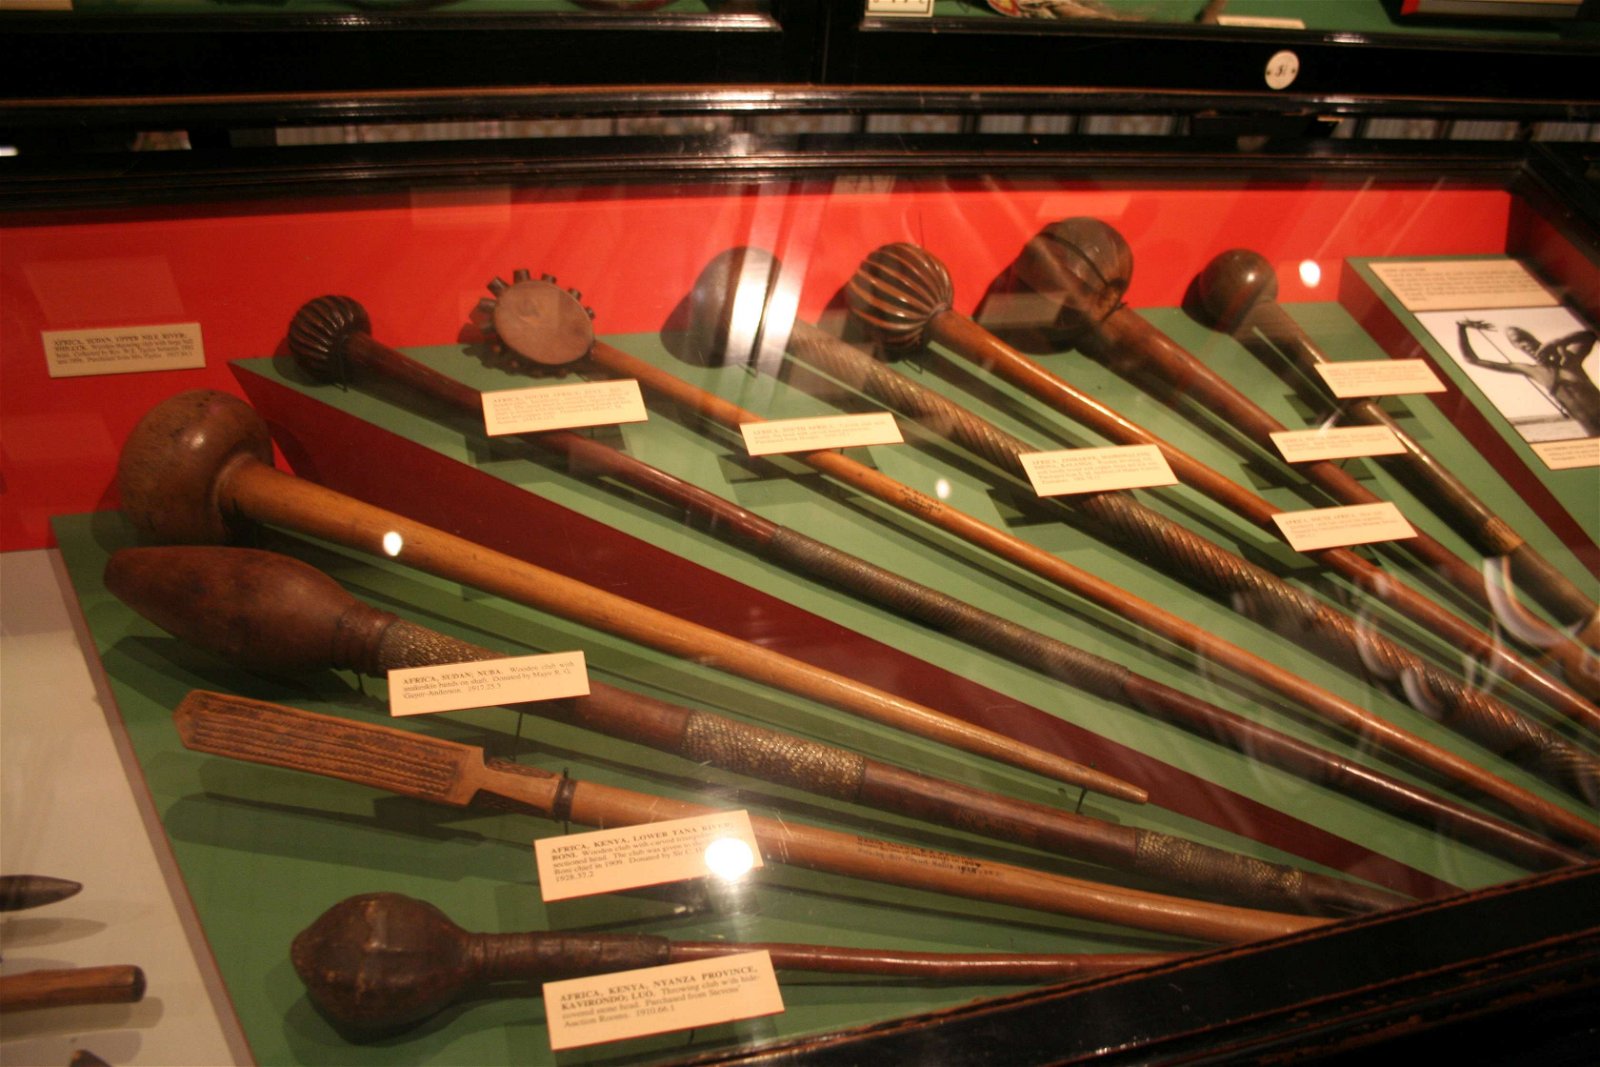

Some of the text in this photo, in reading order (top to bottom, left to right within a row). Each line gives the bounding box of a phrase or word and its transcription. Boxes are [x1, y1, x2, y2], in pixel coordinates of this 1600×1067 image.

[404, 676, 439, 685] AFRICA,
[552, 844, 590, 855] AFRICA,
[595, 838, 630, 849] KENYA,
[634, 832, 668, 842] LOWER
[673, 828, 697, 836] TANA
[561, 966, 758, 1003] AFRICA, KENYA, NYANZA PROVINCE,
[662, 984, 700, 996] Throwing
[702, 981, 719, 989] club
[721, 978, 739, 986] with
[646, 995, 686, 1007] Purchased
[688, 992, 707, 1000] from
